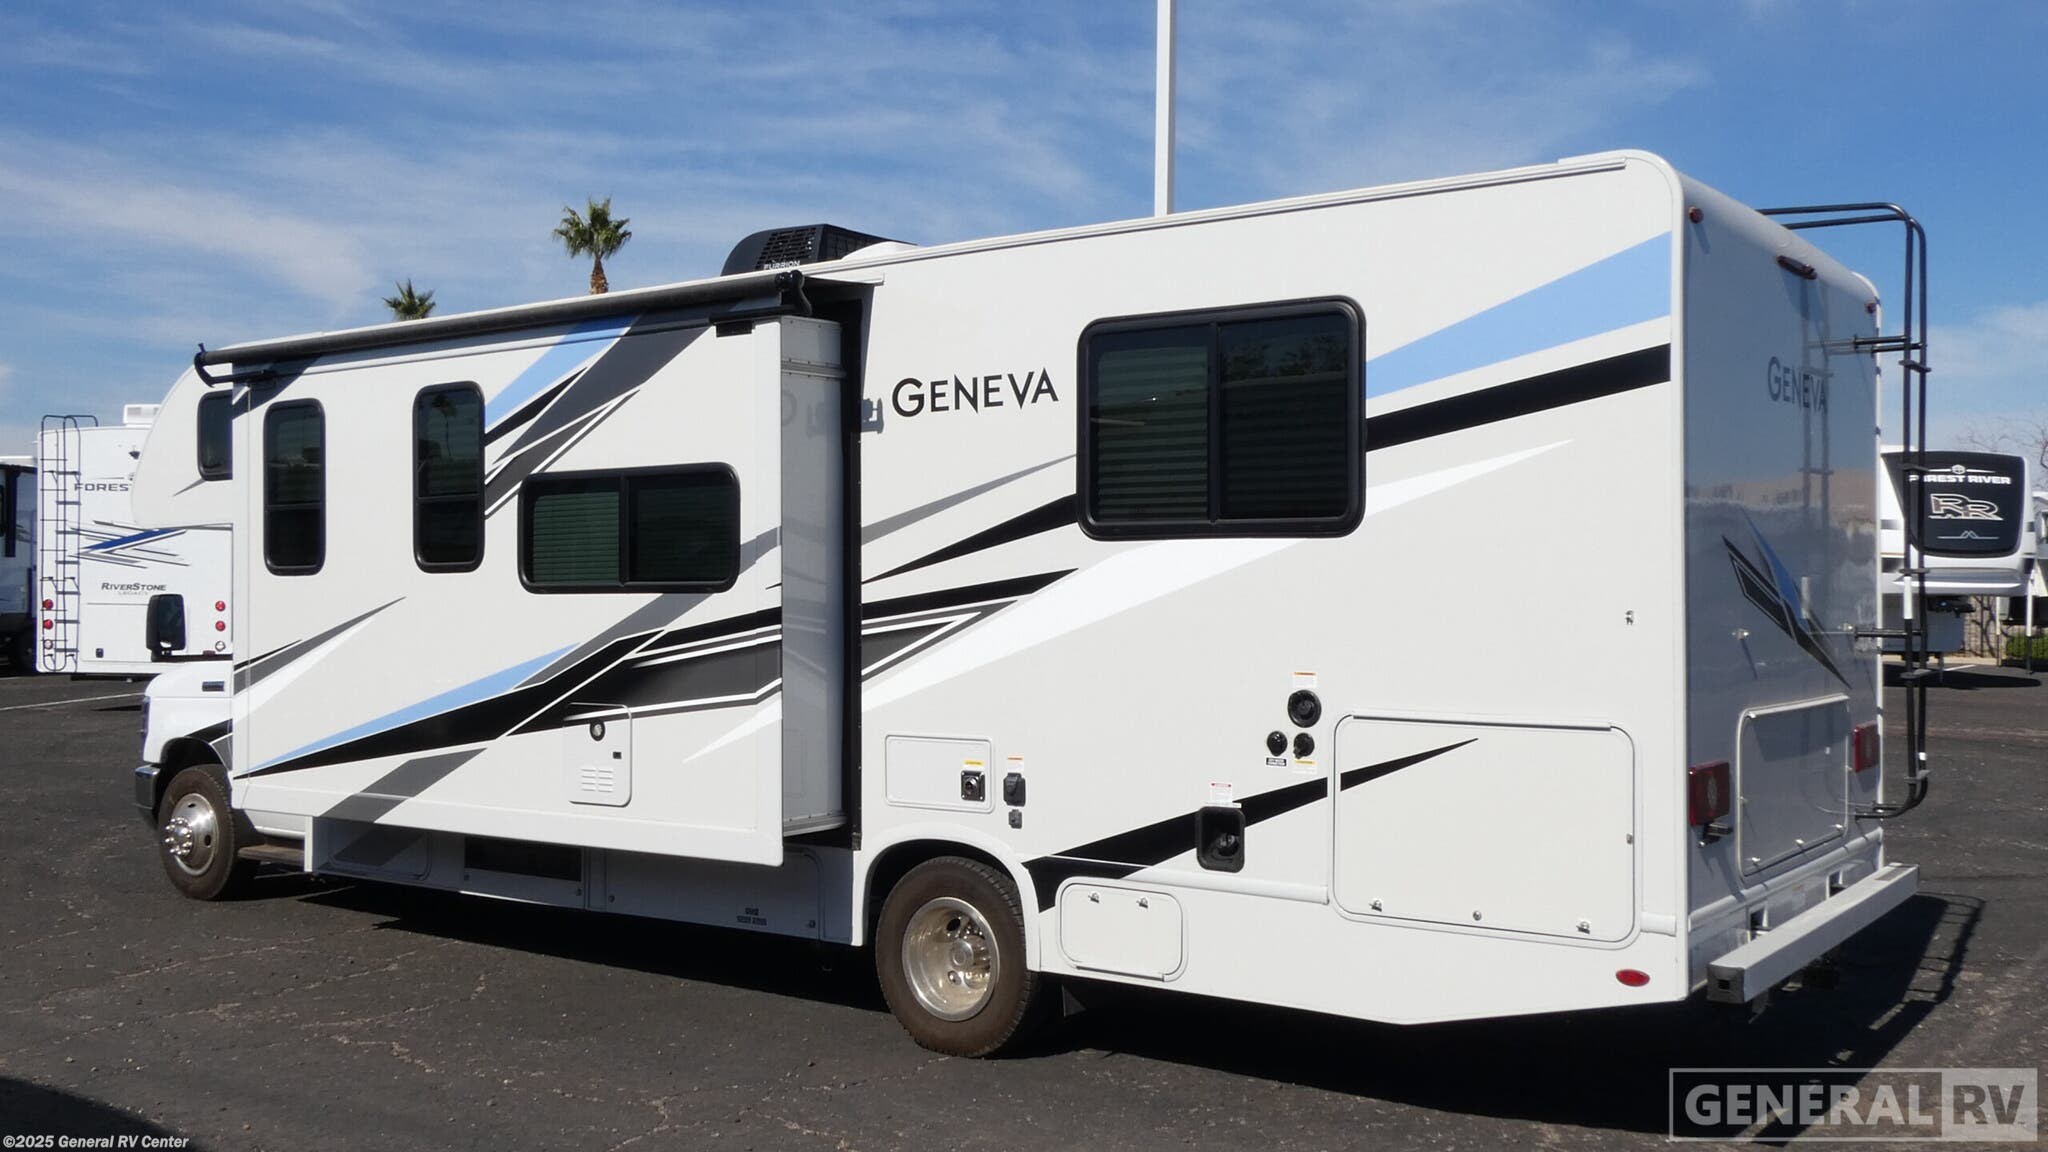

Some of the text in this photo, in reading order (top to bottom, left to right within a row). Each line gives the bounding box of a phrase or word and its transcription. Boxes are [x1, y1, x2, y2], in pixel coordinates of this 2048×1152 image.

[892, 367, 1059, 417] GENEVA
[1767, 356, 1828, 415] GENEVA
[74, 483, 131, 491] FORES
[1967, 474, 2012, 485] RIVER
